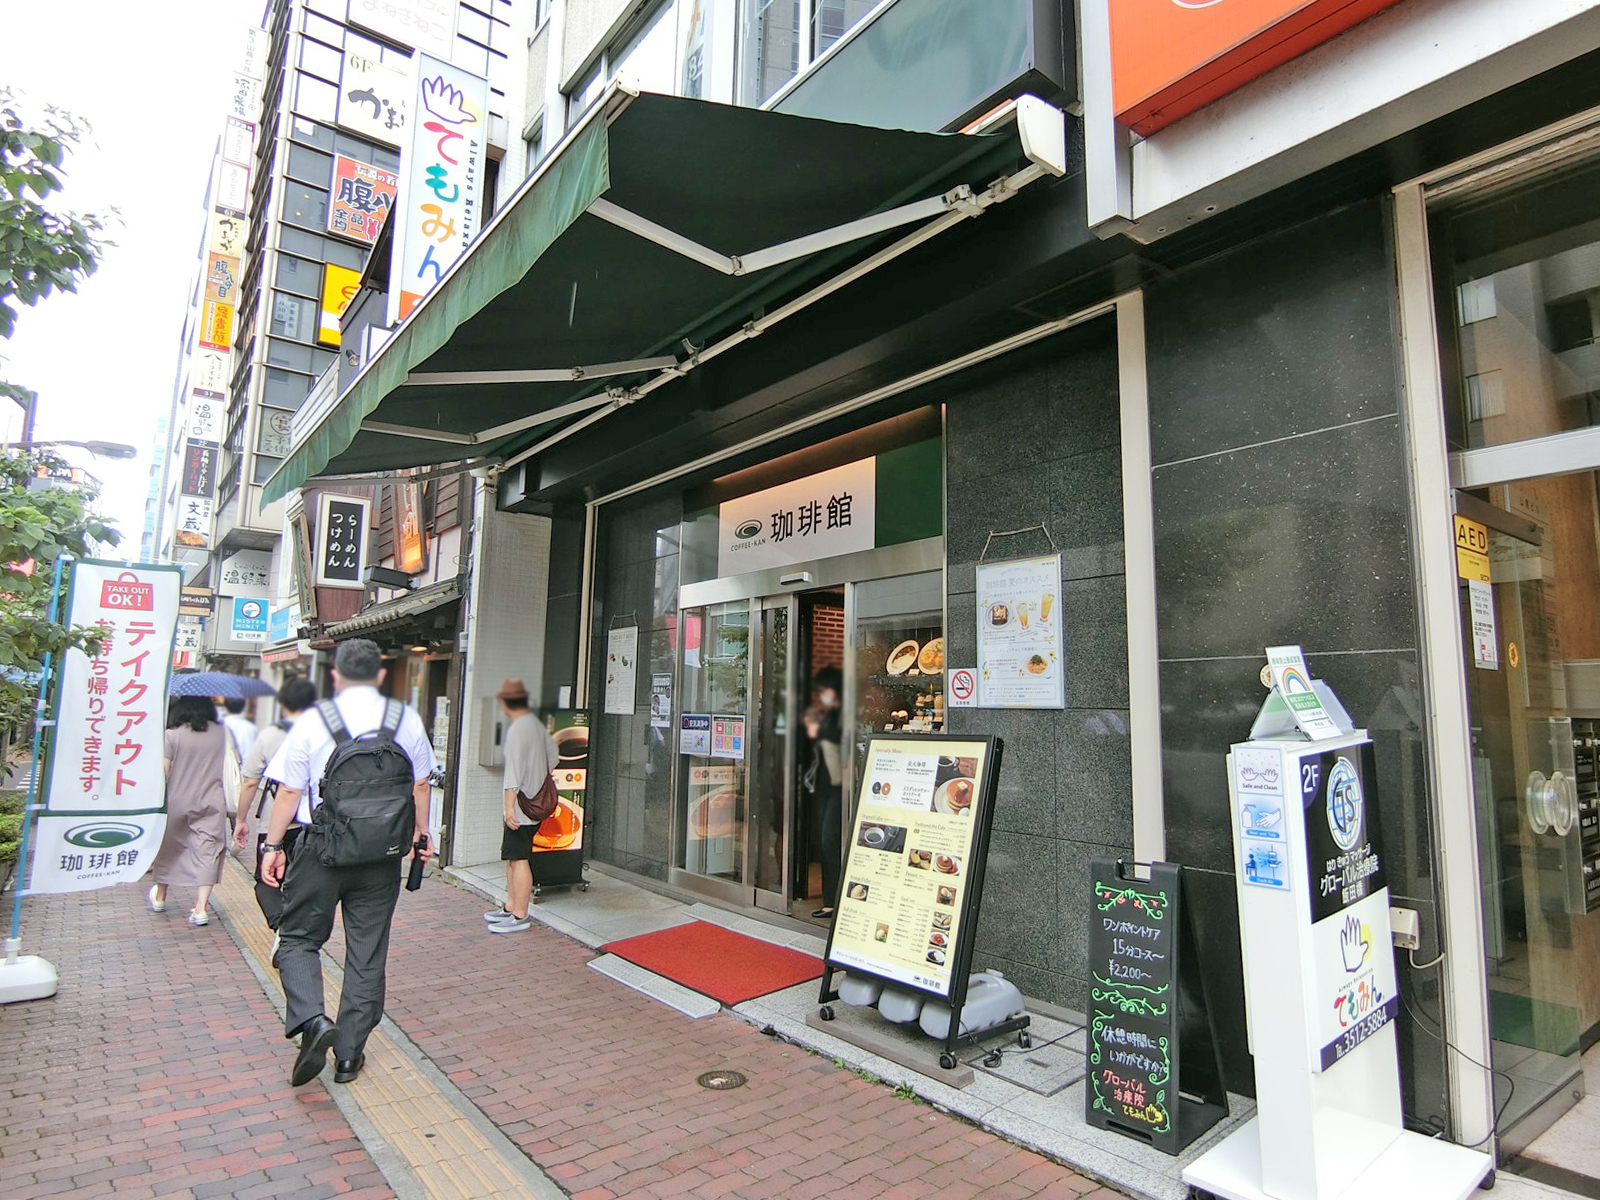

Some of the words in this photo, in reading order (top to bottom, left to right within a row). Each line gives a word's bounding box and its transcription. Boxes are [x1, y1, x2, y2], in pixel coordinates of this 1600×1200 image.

[465, 139, 479, 192] Always
[417, 120, 463, 282] てもみん
[461, 198, 475, 253] Relaxa
[770, 491, 853, 543] 珈琲館
[328, 513, 345, 568] つけめん
[343, 514, 359, 569] らーめん
[1457, 524, 1486, 550] AED
[107, 585, 129, 594] TAKE
[131, 586, 150, 595] OUT
[114, 621, 156, 795] テイクアウト
[1302, 764, 1319, 794] 2F
[60, 849, 139, 871] 珈琲館
[1320, 853, 1379, 897] グローバル治療院
[1326, 859, 1337, 873] はり
[1103, 918, 1161, 941] ワンポイントケア
[1334, 975, 1382, 1027] てもみん
[1101, 1025, 1157, 1049] 休憩時間に
[1103, 1069, 1146, 1094] グローバル
[1114, 1089, 1145, 1108] 治療院
[1122, 1104, 1147, 1121] てもみん
